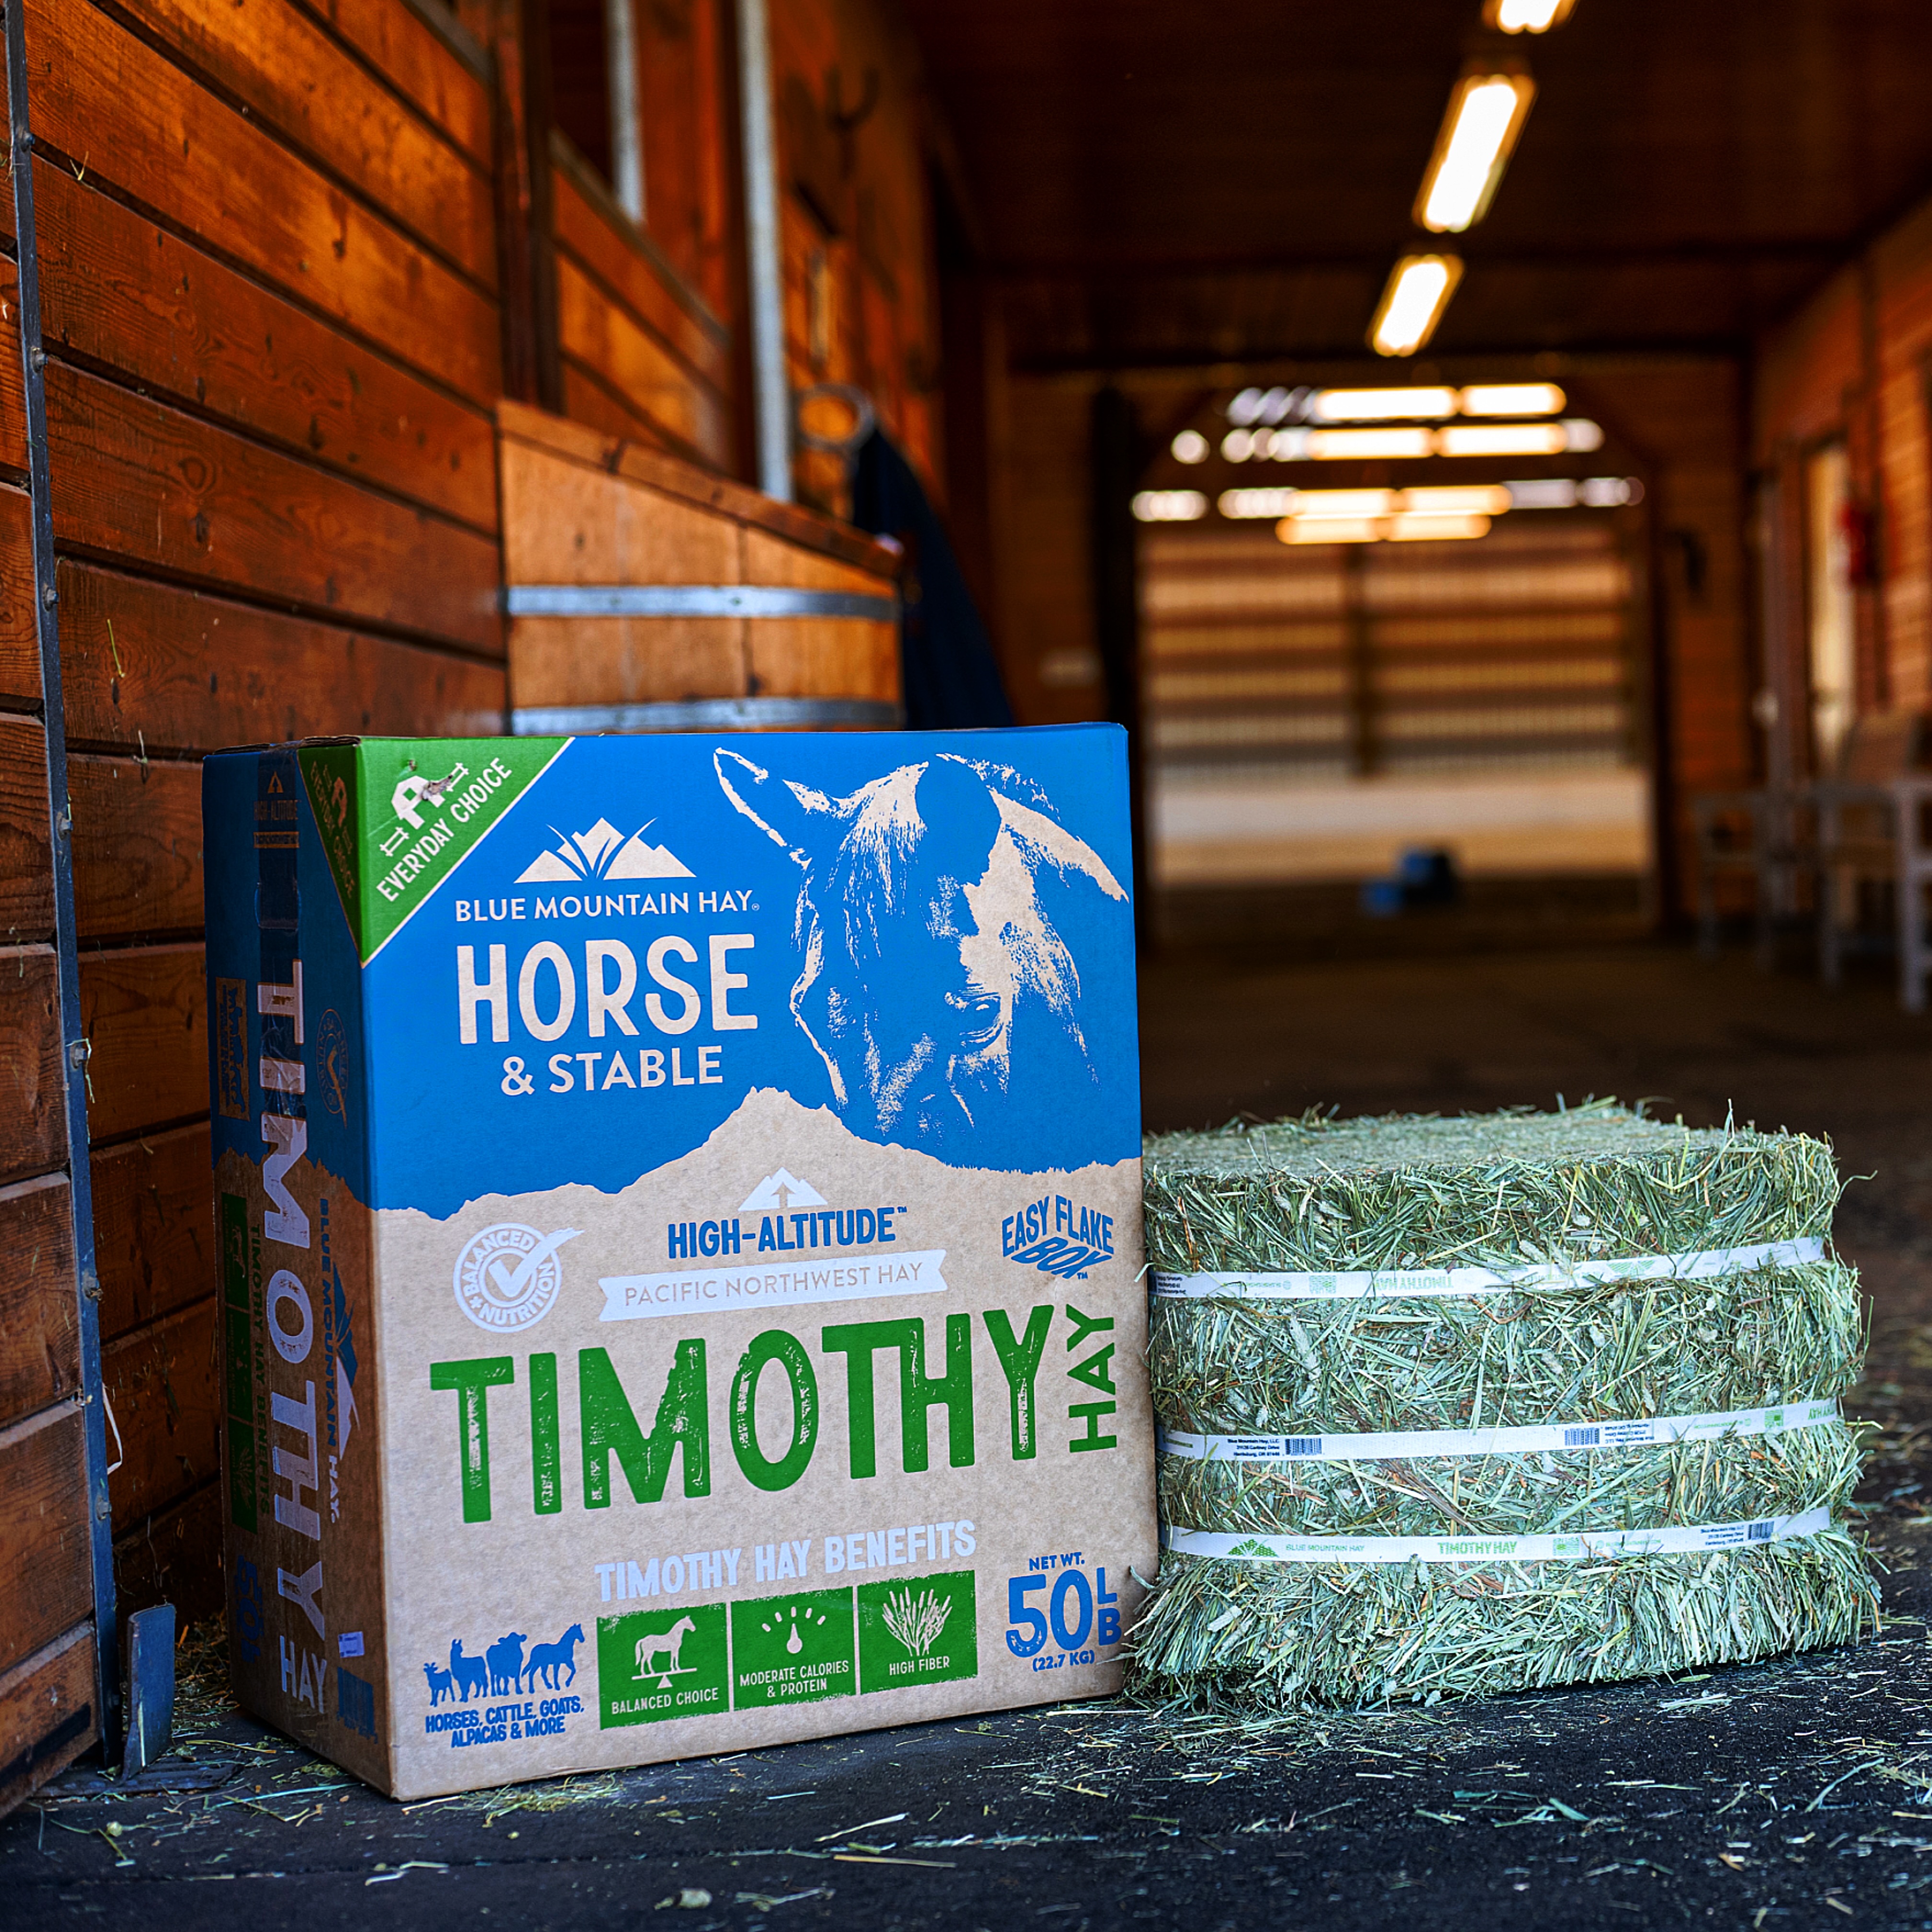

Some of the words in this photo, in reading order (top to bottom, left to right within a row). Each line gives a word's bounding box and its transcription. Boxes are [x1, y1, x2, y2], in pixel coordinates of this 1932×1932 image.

[376, 818, 455, 902] EVERYDAY
[450, 757, 512, 823] CHOICE
[455, 897, 526, 922] BLUE
[534, 892, 690, 919] MOUNTAIN
[456, 933, 758, 1045] HORSE
[501, 1057, 535, 1096] &
[549, 1045, 724, 1093] STABLE
[320, 1198, 331, 1271] BLUE
[1002, 1196, 1050, 1257] EASY
[1056, 1194, 1114, 1254] FLAKE
[252, 1224, 263, 1332] TIMOTHY
[461, 1230, 535, 1297] BALANCED
[625, 1279, 717, 1307] PACIFIC
[726, 1267, 871, 1298] NORTHWEST
[878, 1262, 923, 1284] HAY
[257, 959, 324, 1640] TIMOTHY
[479, 1262, 555, 1326] NUTRITION
[254, 1343, 265, 1388] HAY
[322, 1280, 336, 1447] MOUNTAIN
[430, 1305, 1054, 1523] TIMOTHY
[1066, 1303, 1117, 1452] HAY
[257, 1395, 269, 1515] BENEFITS
[595, 1548, 741, 1602] TIMOTHY
[755, 1540, 811, 1582] HAY
[824, 1519, 976, 1573] BENEFITS
[1029, 1555, 1057, 1571] NET
[1060, 1552, 1085, 1567] WT.
[1286, 1544, 1305, 1552] BLUE
[1307, 1544, 1345, 1552] MOUNTAIN
[1347, 1544, 1365, 1552] HAY
[1438, 1541, 1491, 1554] TIMOTHY
[1493, 1541, 1518, 1554] HAY
[1006, 1569, 1093, 1657] 50
[280, 1634, 327, 1713] HAY
[739, 1668, 796, 1687] MODERATE
[800, 1660, 849, 1679] CALORIES
[767, 1685, 776, 1698] &
[781, 1678, 828, 1695] PROTEIN
[889, 1659, 915, 1676] HIGH
[919, 1656, 950, 1672] FIBER
[1033, 1654, 1065, 1672] (22.7
[1070, 1650, 1095, 1666] KG)
[426, 1710, 483, 1733] HORSES,
[485, 1702, 537, 1725] CATTLE,
[540, 1695, 584, 1717] GOATS,
[611, 1695, 671, 1715] BALANCED
[676, 1688, 719, 1704] CHOICE
[451, 1724, 507, 1748] ALPACAS
[510, 1723, 522, 1740] &
[525, 1715, 566, 1737] MORE
